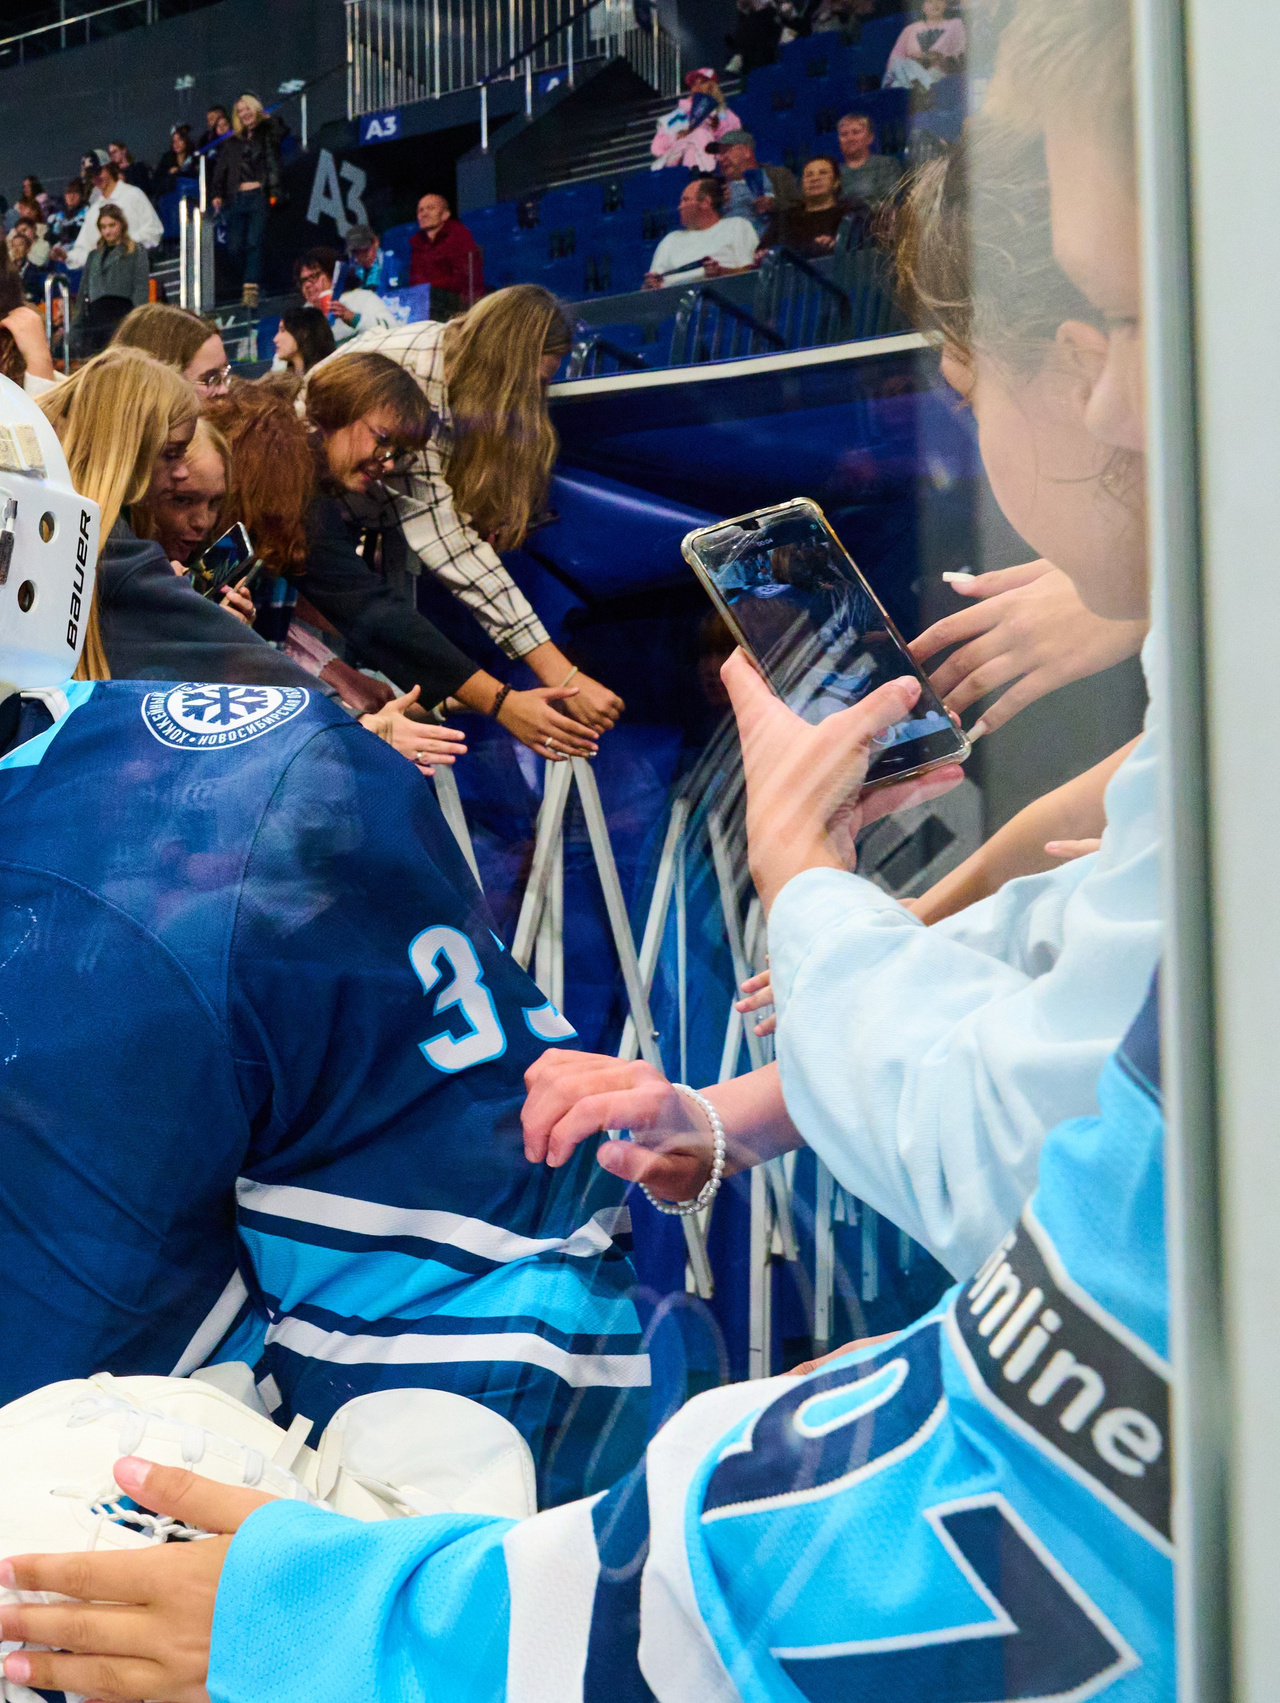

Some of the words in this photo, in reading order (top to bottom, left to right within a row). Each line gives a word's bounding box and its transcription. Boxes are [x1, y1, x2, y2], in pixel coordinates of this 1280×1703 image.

[307, 149, 368, 239] A3
[365, 116, 397, 140] A3
[66, 509, 91, 651] BAUER
[408, 924, 578, 1074] 3
[967, 1229, 1163, 1478] inline
